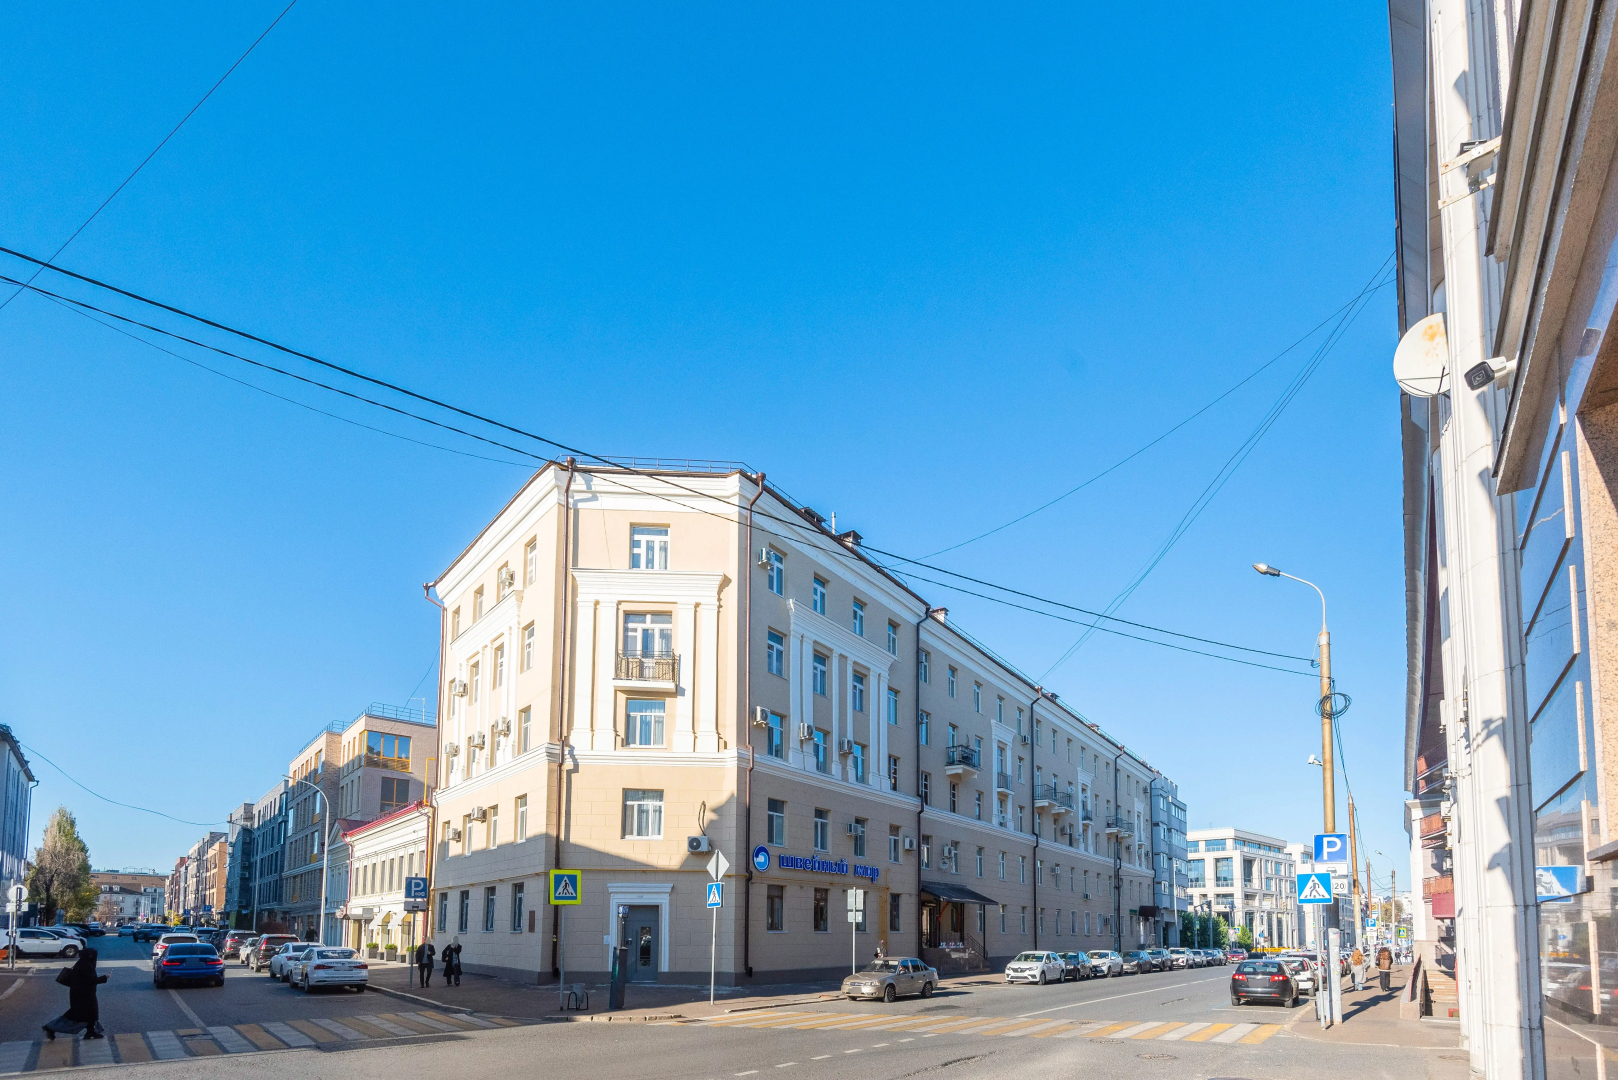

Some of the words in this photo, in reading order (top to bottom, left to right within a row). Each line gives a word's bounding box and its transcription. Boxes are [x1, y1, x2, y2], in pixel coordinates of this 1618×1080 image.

[1323, 837, 1341, 860] P
[854, 864, 880, 883] мир
[411, 879, 424, 896] P
